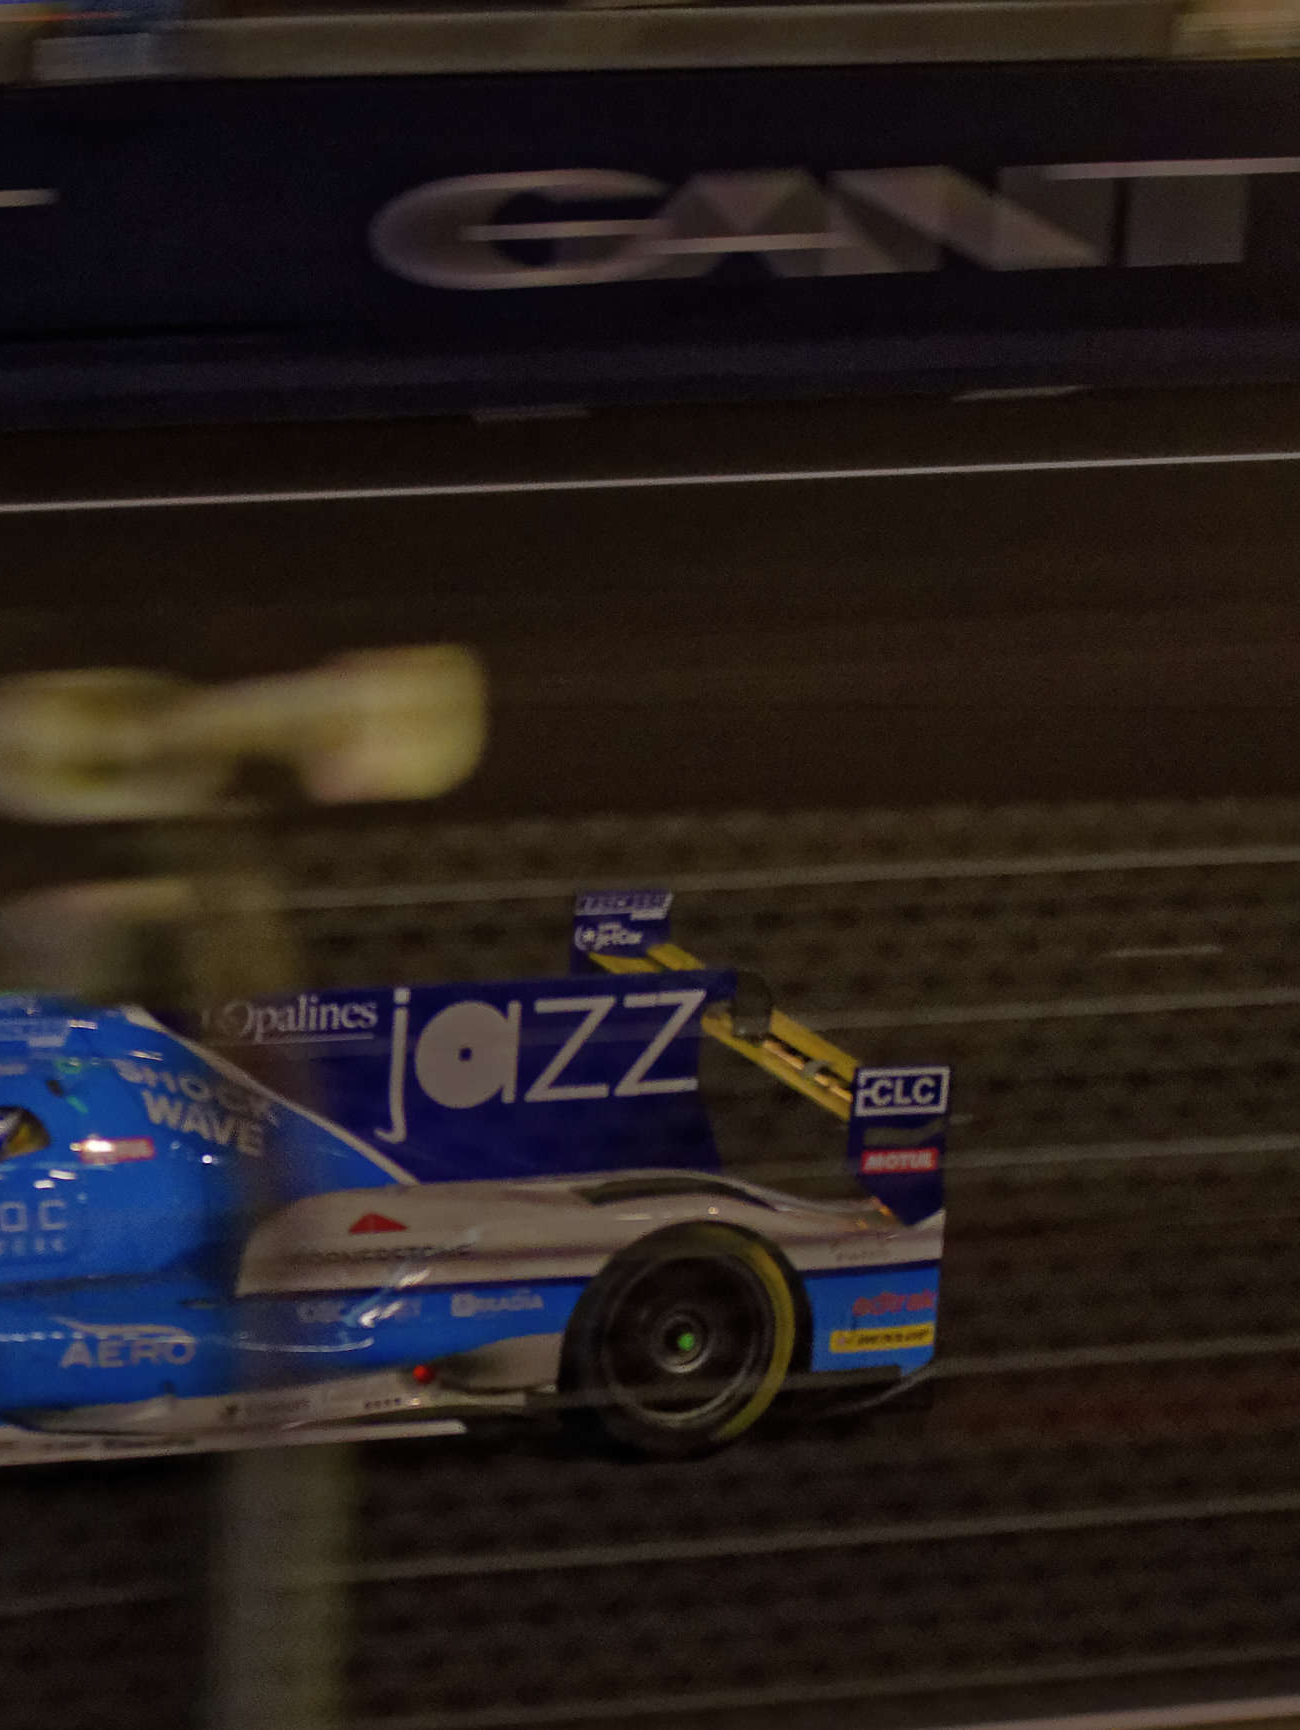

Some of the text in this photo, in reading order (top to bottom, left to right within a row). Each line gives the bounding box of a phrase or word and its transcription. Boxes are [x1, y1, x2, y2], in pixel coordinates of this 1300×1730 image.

[366, 153, 1300, 291] GANT
[220, 994, 378, 1044] Opalines
[372, 987, 707, 1143] jazz
[870, 1076, 937, 1107] CLC
[141, 1088, 264, 1158] WAVE
[58, 1337, 197, 1369] AERO
